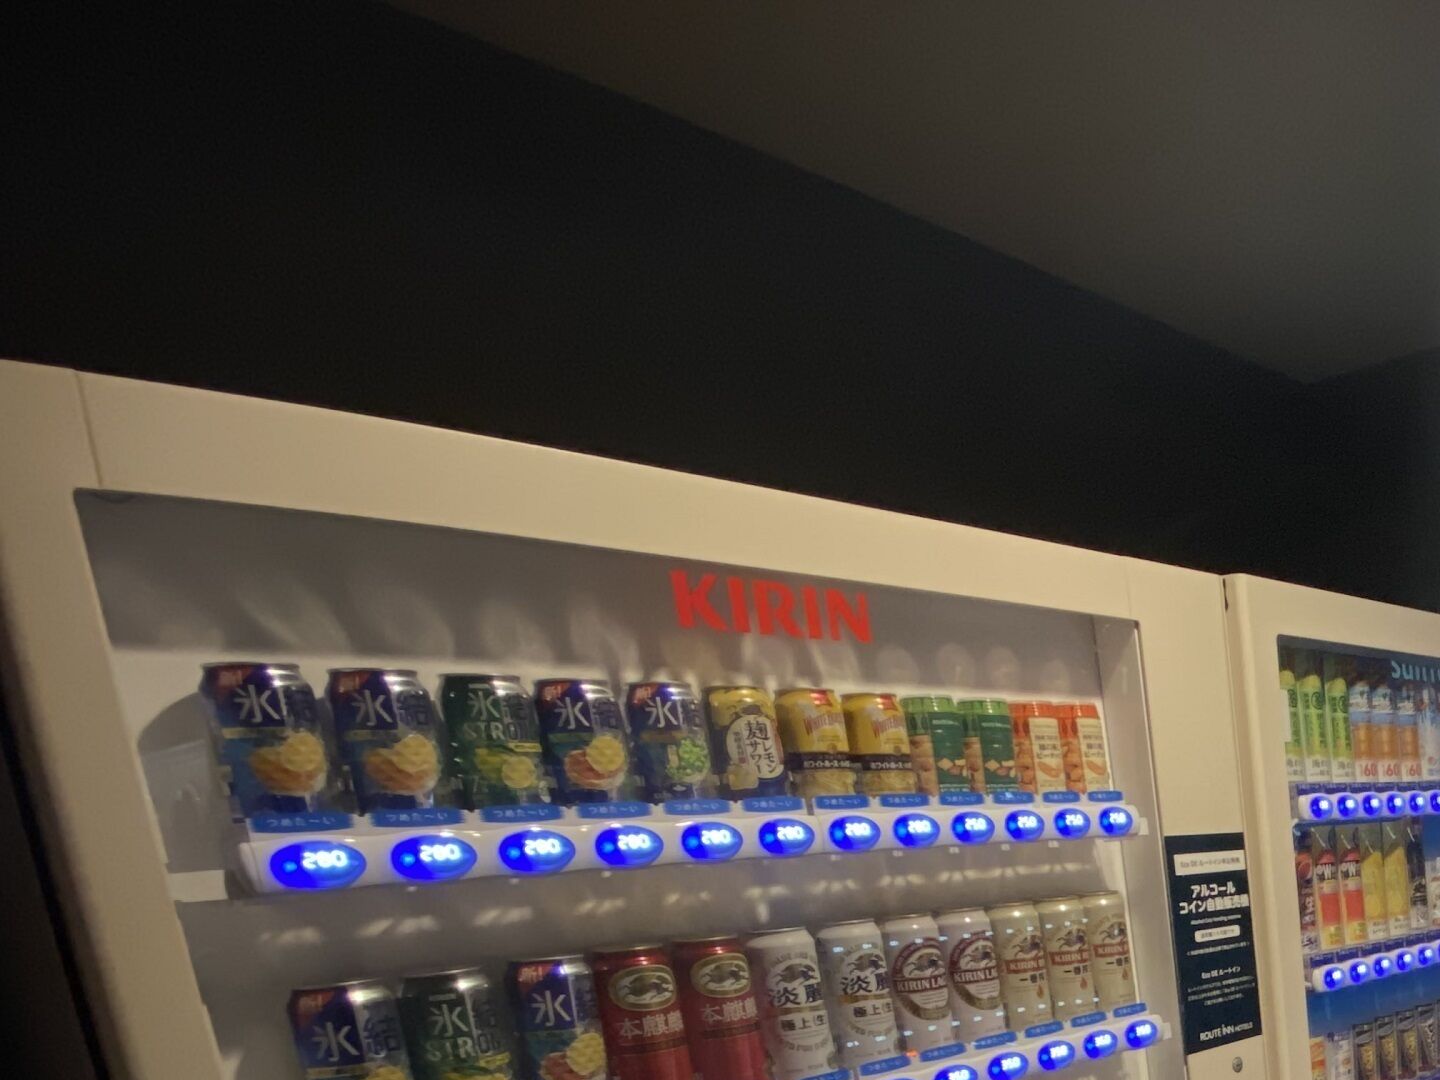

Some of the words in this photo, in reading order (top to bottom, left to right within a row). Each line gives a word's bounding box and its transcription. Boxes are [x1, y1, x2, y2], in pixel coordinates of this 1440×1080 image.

[669, 569, 875, 644] KIRIN
[845, 822, 871, 837] 280
[907, 819, 932, 834] 280
[964, 817, 987, 831] 250
[1017, 815, 1038, 829] 250
[701, 828, 733, 845] 280
[776, 825, 805, 841] 280
[524, 837, 562, 856] 280
[617, 833, 652, 851] 280
[302, 849, 348, 870] 280
[419, 843, 462, 863] 280
[1190, 880, 1235, 899] アルコール
[1054, 953, 1082, 964] KIRIN
[1009, 961, 1038, 972] KIRIN
[953, 970, 985, 983] KIRIN
[896, 980, 930, 992] KIRIN
[1199, 1028, 1222, 1042] ROUTE
